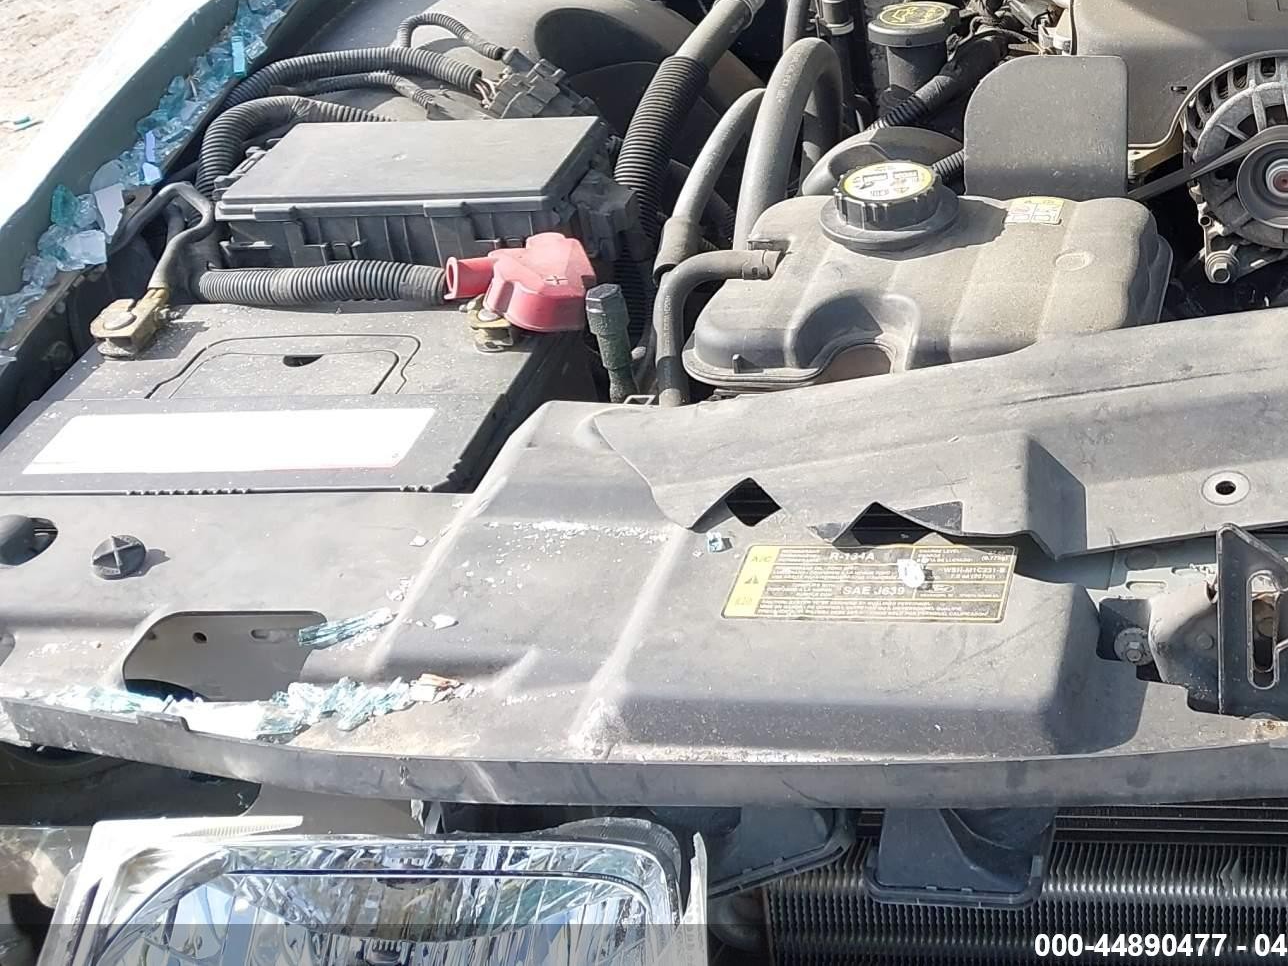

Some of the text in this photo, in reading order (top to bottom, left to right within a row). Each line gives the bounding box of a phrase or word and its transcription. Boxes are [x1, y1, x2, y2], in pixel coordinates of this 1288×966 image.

[828, 551, 876, 562] R-134A
[842, 585, 871, 596] SAE
[873, 585, 906, 597] J639
